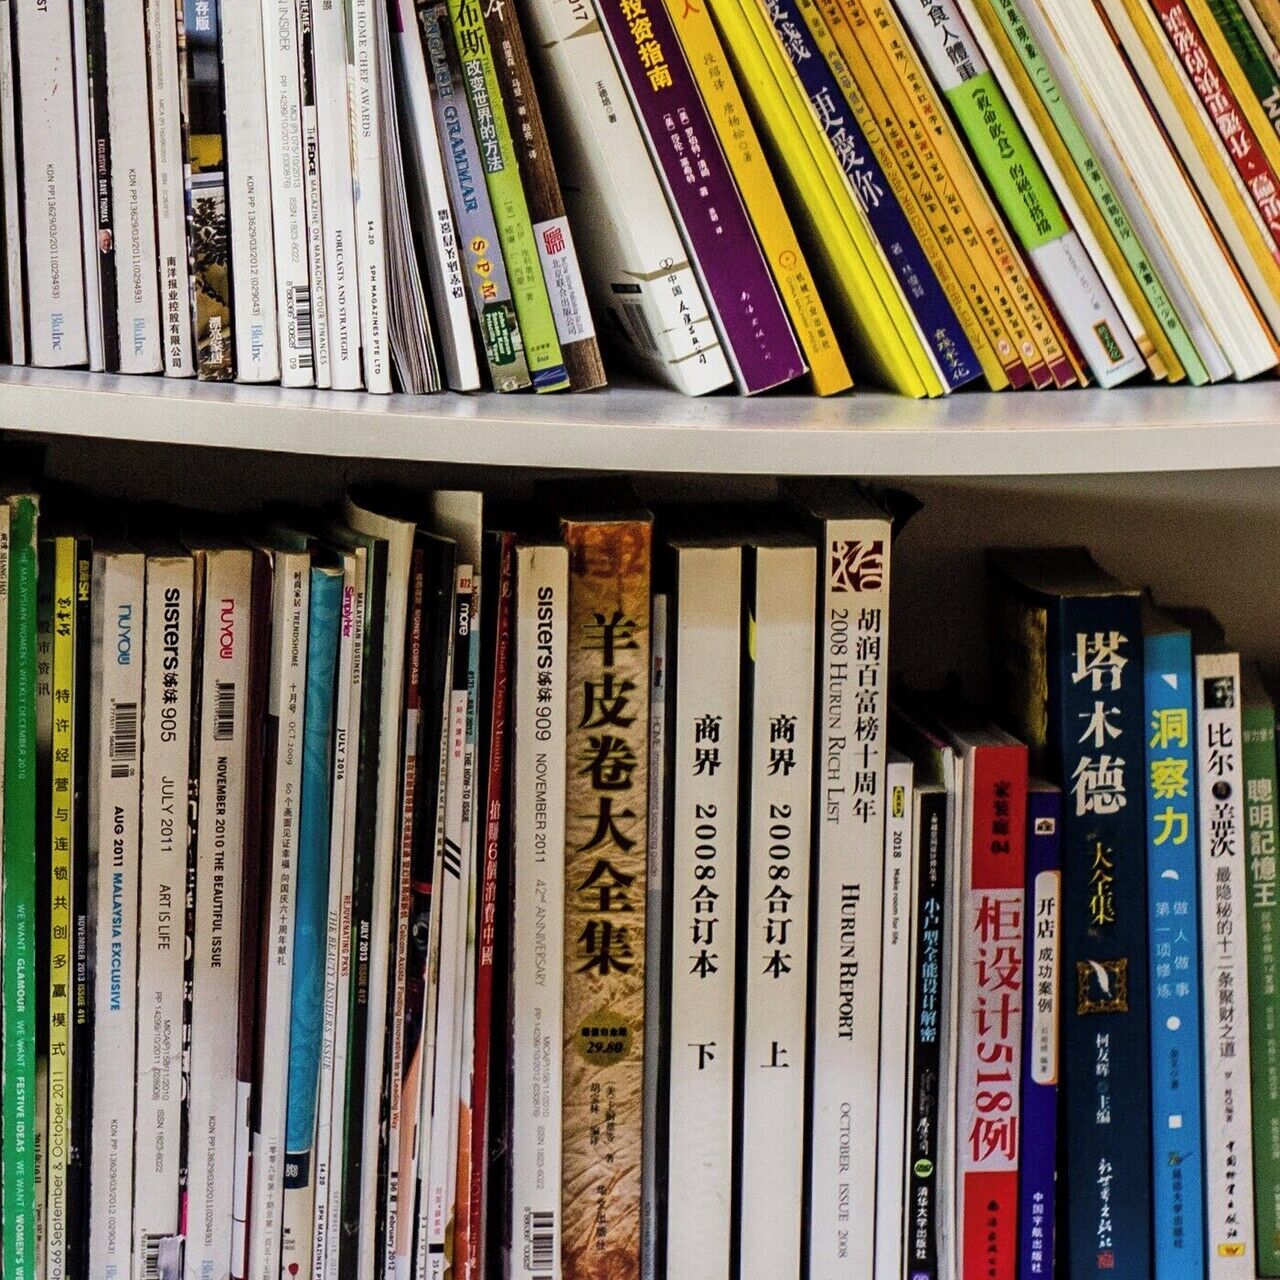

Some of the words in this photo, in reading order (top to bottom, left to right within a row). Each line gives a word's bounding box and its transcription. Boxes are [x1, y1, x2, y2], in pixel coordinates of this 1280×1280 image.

[278, 2, 290, 51] INSIDER
[357, 9, 366, 43] HOME
[358, 47, 368, 82] CHEF
[360, 86, 371, 138] AWARDS
[443, 105, 479, 213] GRAMMAR
[291, 610, 301, 668] TRENDSHOME
[458, 603, 470, 635] more
[831, 608, 849, 656] 2008
[161, 708, 178, 742] 905
[535, 707, 551, 741] 909
[852, 607, 881, 824] 胡润百富榜十周年
[1071, 630, 1129, 817] 塔木德
[693, 713, 722, 777] 商界
[767, 713, 797, 777] 商界
[161, 776, 174, 814] JULY
[215, 756, 227, 815] NOVEMBER
[535, 753, 547, 830] NOVEMBER
[576, 611, 640, 975] 羊皮卷大全集
[1149, 708, 1189, 846] 洞察力
[114, 805, 124, 835] AUG
[161, 818, 174, 852] 2011
[215, 818, 225, 847] 2010
[114, 839, 124, 867] 2011
[214, 851, 225, 871] THE
[535, 835, 545, 863] 2011
[893, 831, 902, 858] 2018
[111, 872, 123, 939] MALAYSIA
[159, 884, 171, 909] ART
[212, 875, 224, 932] BEAUTIFUL
[689, 803, 720, 978] 2008合订本
[762, 803, 793, 978] 2008合订本
[1090, 841, 1115, 925] 大全集
[158, 913, 171, 925] IS
[158, 928, 171, 950] LIFE
[1037, 898, 1055, 939] 开店
[211, 936, 222, 968] ISSUE
[535, 907, 546, 987] ANNIVERSARY
[16, 958, 26, 1013] GLAMOUR
[110, 943, 122, 1011] EXCLUSIVE
[1037, 947, 1055, 1014] 成功案例
[968, 896, 1022, 1162] 柜设计518例
[687, 1041, 716, 1070] 下
[760, 1041, 789, 1068] 上
[16, 1077, 25, 1118] FESTIVE
[53, 1070, 65, 1100] 2011
[16, 1120, 25, 1153] IDEAS
[52, 1103, 65, 1157] October
[839, 1102, 851, 1173] OCTOBER
[52, 1184, 66, 1247] September
[838, 1184, 849, 1220] ISSUE
[837, 1228, 849, 1260] 2008
